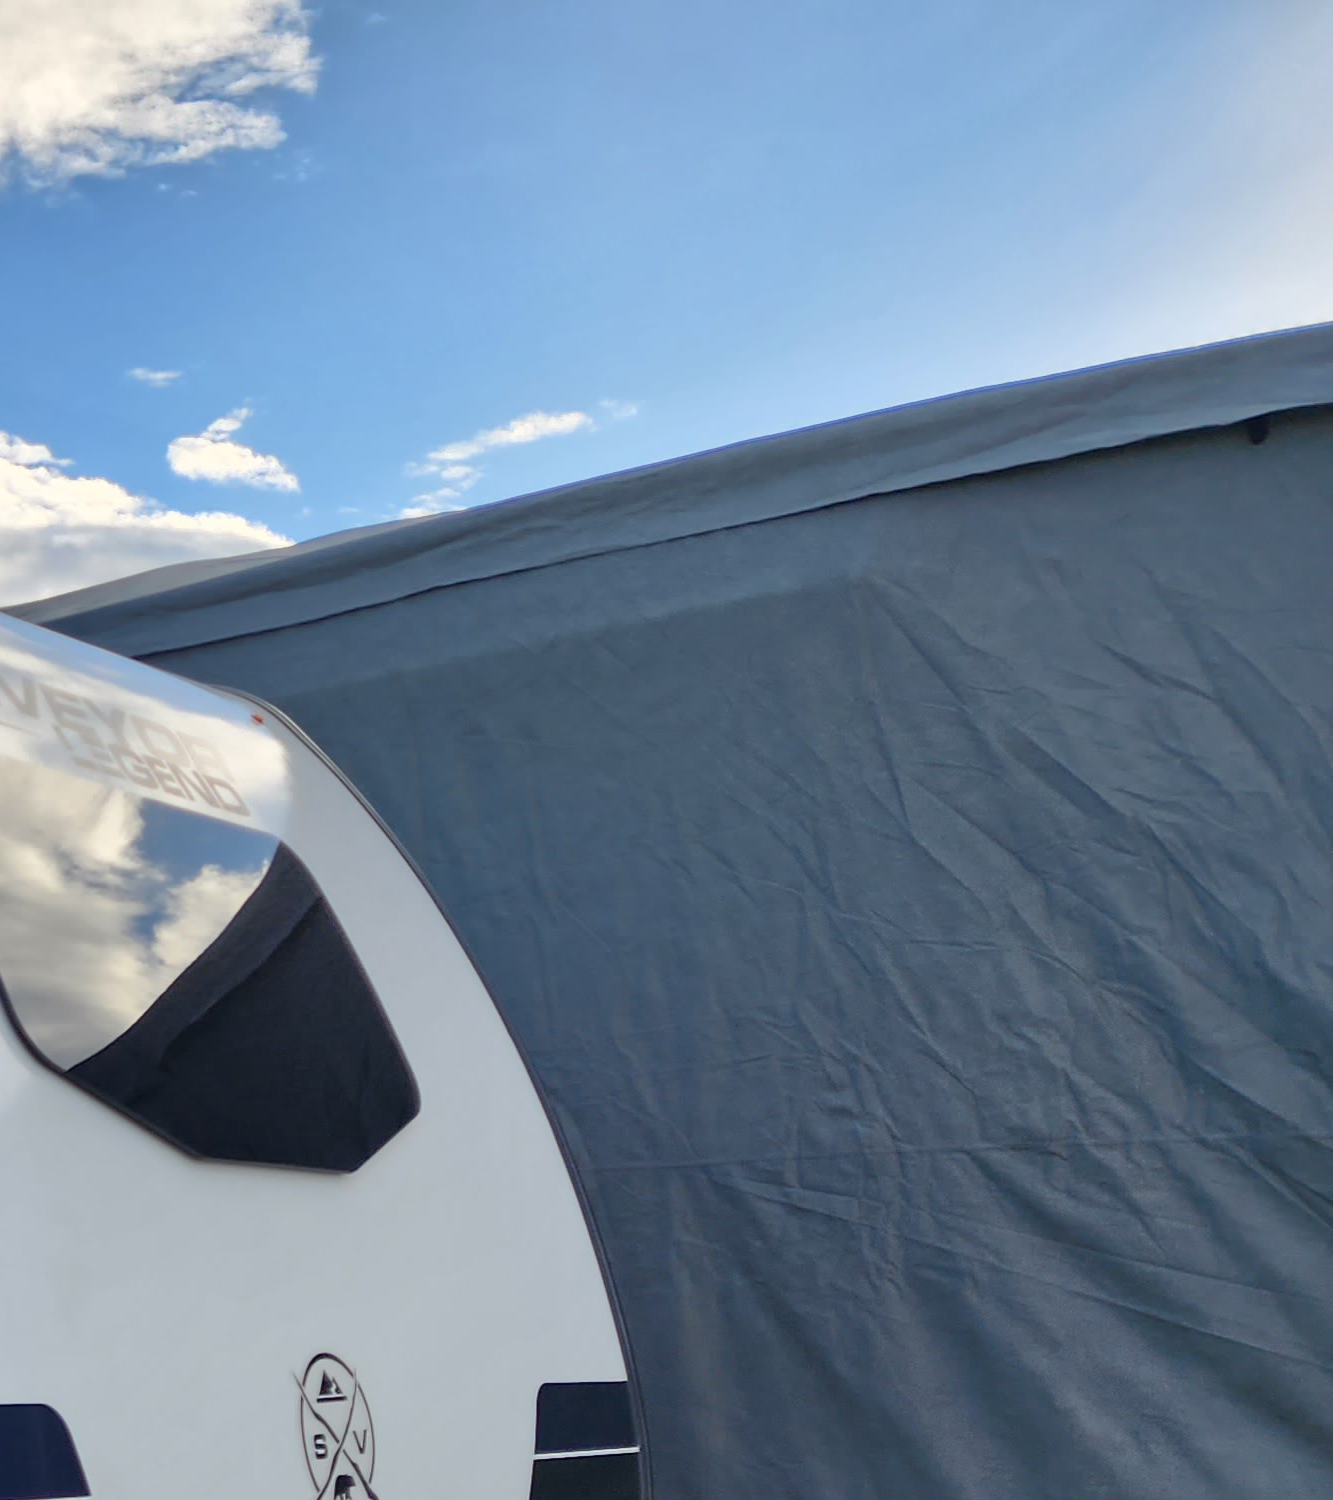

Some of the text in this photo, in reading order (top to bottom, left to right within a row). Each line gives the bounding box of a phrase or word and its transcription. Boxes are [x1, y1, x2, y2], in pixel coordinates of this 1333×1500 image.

[53, 720, 252, 818] LEGEND
[313, 1428, 368, 1460] S V
